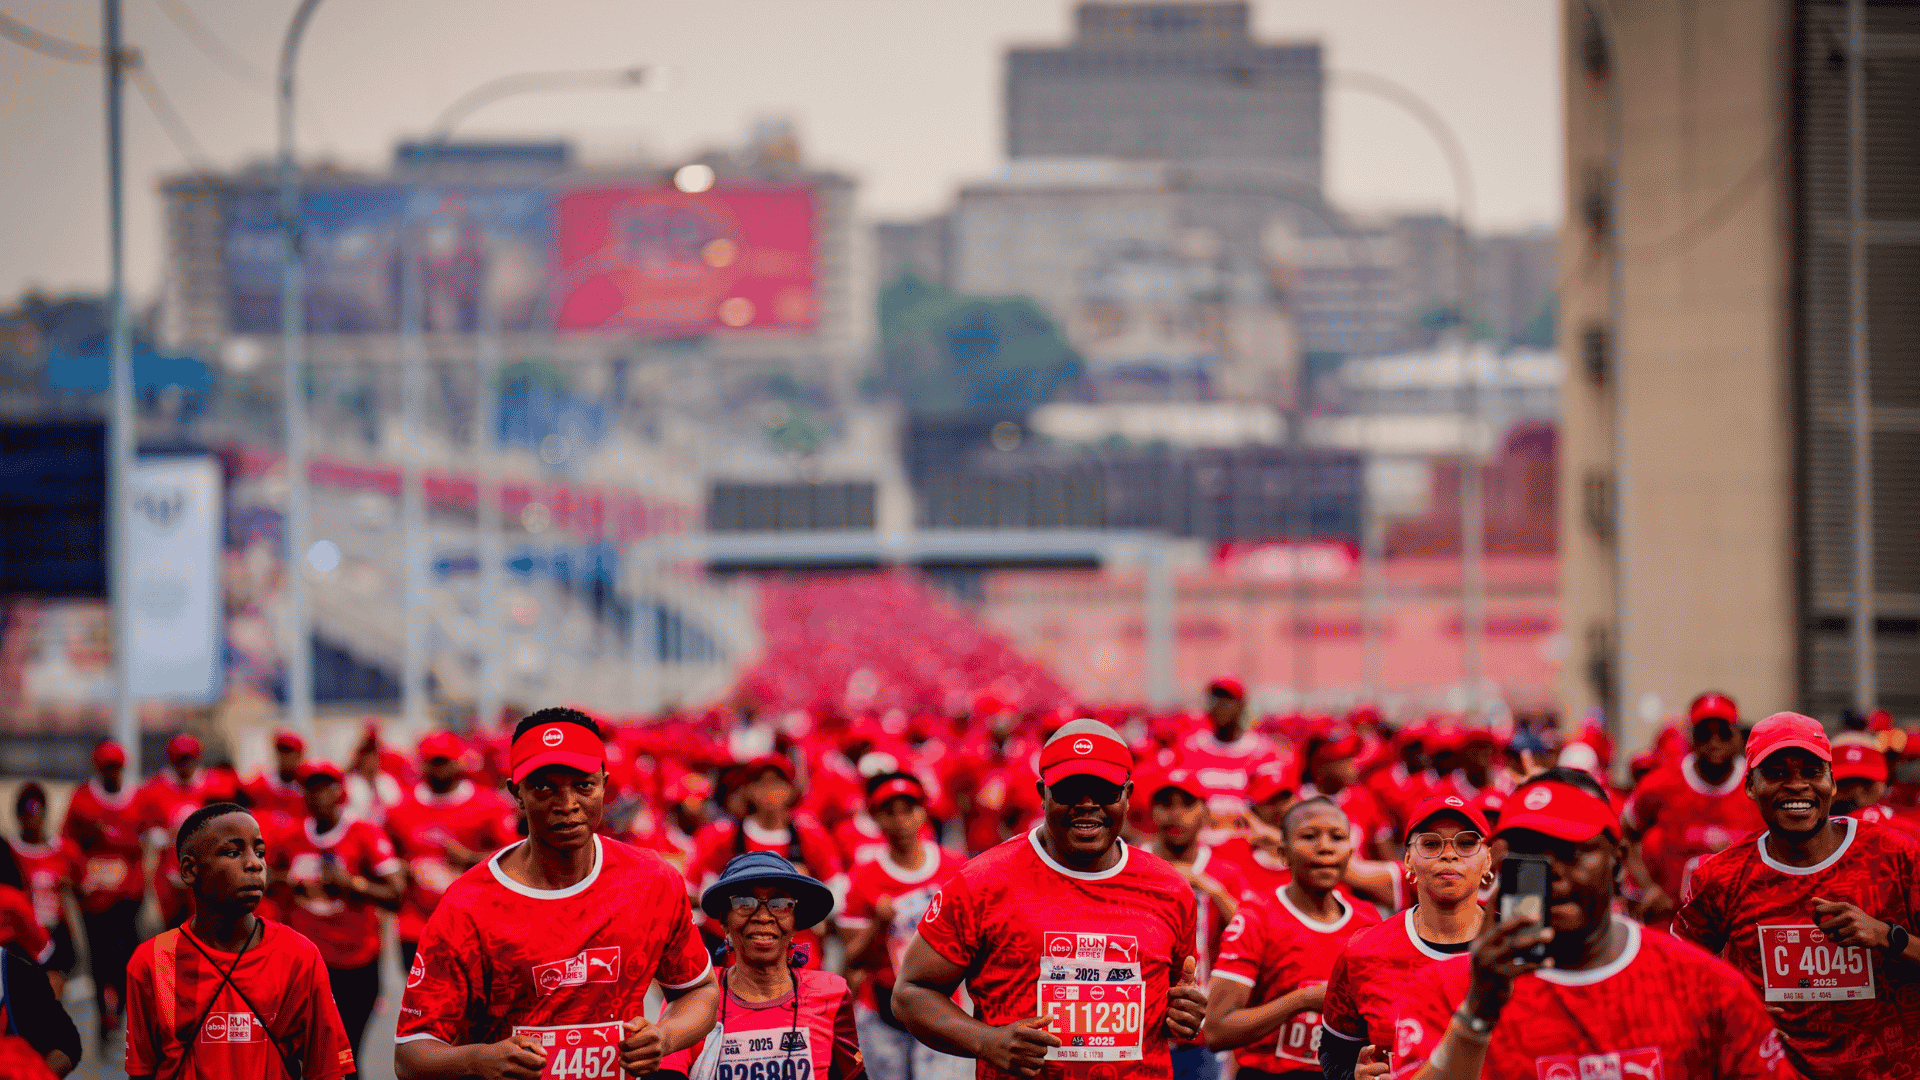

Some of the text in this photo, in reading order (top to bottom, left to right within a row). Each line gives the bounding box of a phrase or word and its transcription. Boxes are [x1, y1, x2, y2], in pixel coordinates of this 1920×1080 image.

[545, 733, 561, 741] absa
[1052, 944, 1071, 952] absa
[1079, 937, 1104, 948] RUN
[1078, 951, 1101, 959] SERIES
[1774, 945, 1863, 976] C 4045
[542, 973, 561, 984] absa
[1075, 968, 1100, 981] 2025
[1109, 969, 1132, 980] ASA
[1813, 978, 1838, 987] 2025
[229, 1016, 249, 1027] RUN
[749, 1037, 773, 1052] 2025
[1088, 1036, 1116, 1046] 2025
[550, 1045, 617, 1080] 4452
